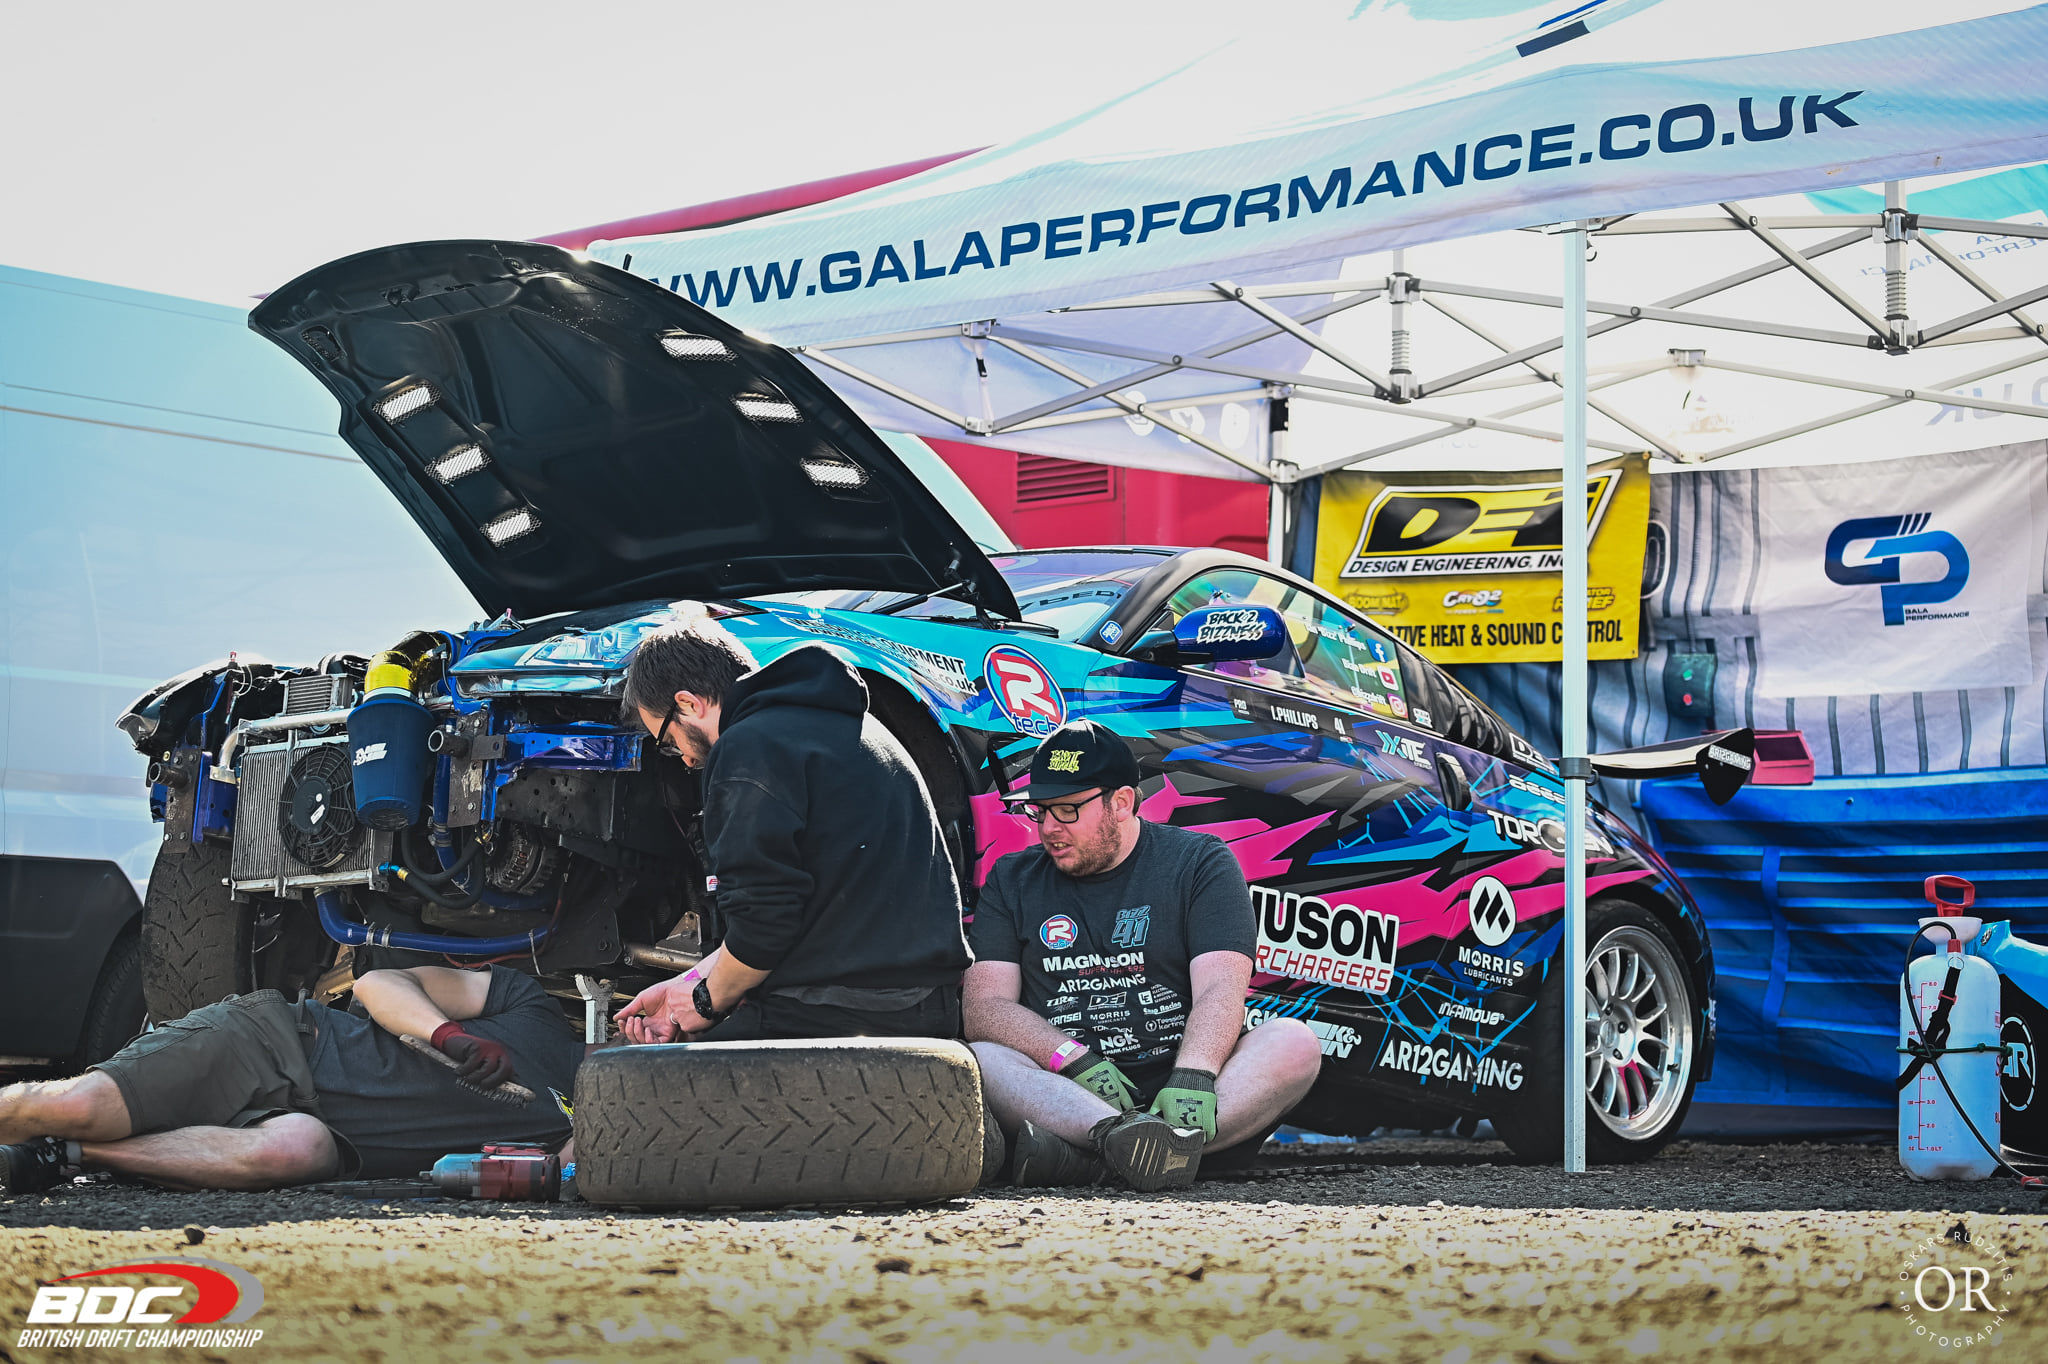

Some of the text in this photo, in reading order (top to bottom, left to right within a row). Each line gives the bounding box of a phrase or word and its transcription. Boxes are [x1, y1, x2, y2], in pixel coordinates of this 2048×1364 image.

[1348, 560, 1408, 574] DESIGN
[1209, 611, 1244, 625] BACK
[1906, 611, 1969, 621] PERFORMANCE
[1199, 623, 1264, 640] BIZZNESS
[1431, 625, 1466, 646] HEAT
[1471, 624, 1482, 646] &
[1487, 622, 1546, 646] SOUND
[1552, 620, 1623, 645] CTROL
[1013, 712, 1059, 735] tech
[1271, 705, 1319, 730] I.PHILLIPS
[1487, 809, 1615, 855] TORQN
[1111, 916, 1150, 949] 41
[1042, 952, 1145, 973] MAGNUSON
[1458, 946, 1524, 977] MORRIS
[1057, 973, 1146, 993] AR12GAMING
[1463, 967, 1514, 987] LUBRICANTS
[1090, 1010, 1131, 1021] MORRIS
[1099, 1032, 1139, 1050] NGK
[1379, 1039, 1523, 1091] AR12GAMING
